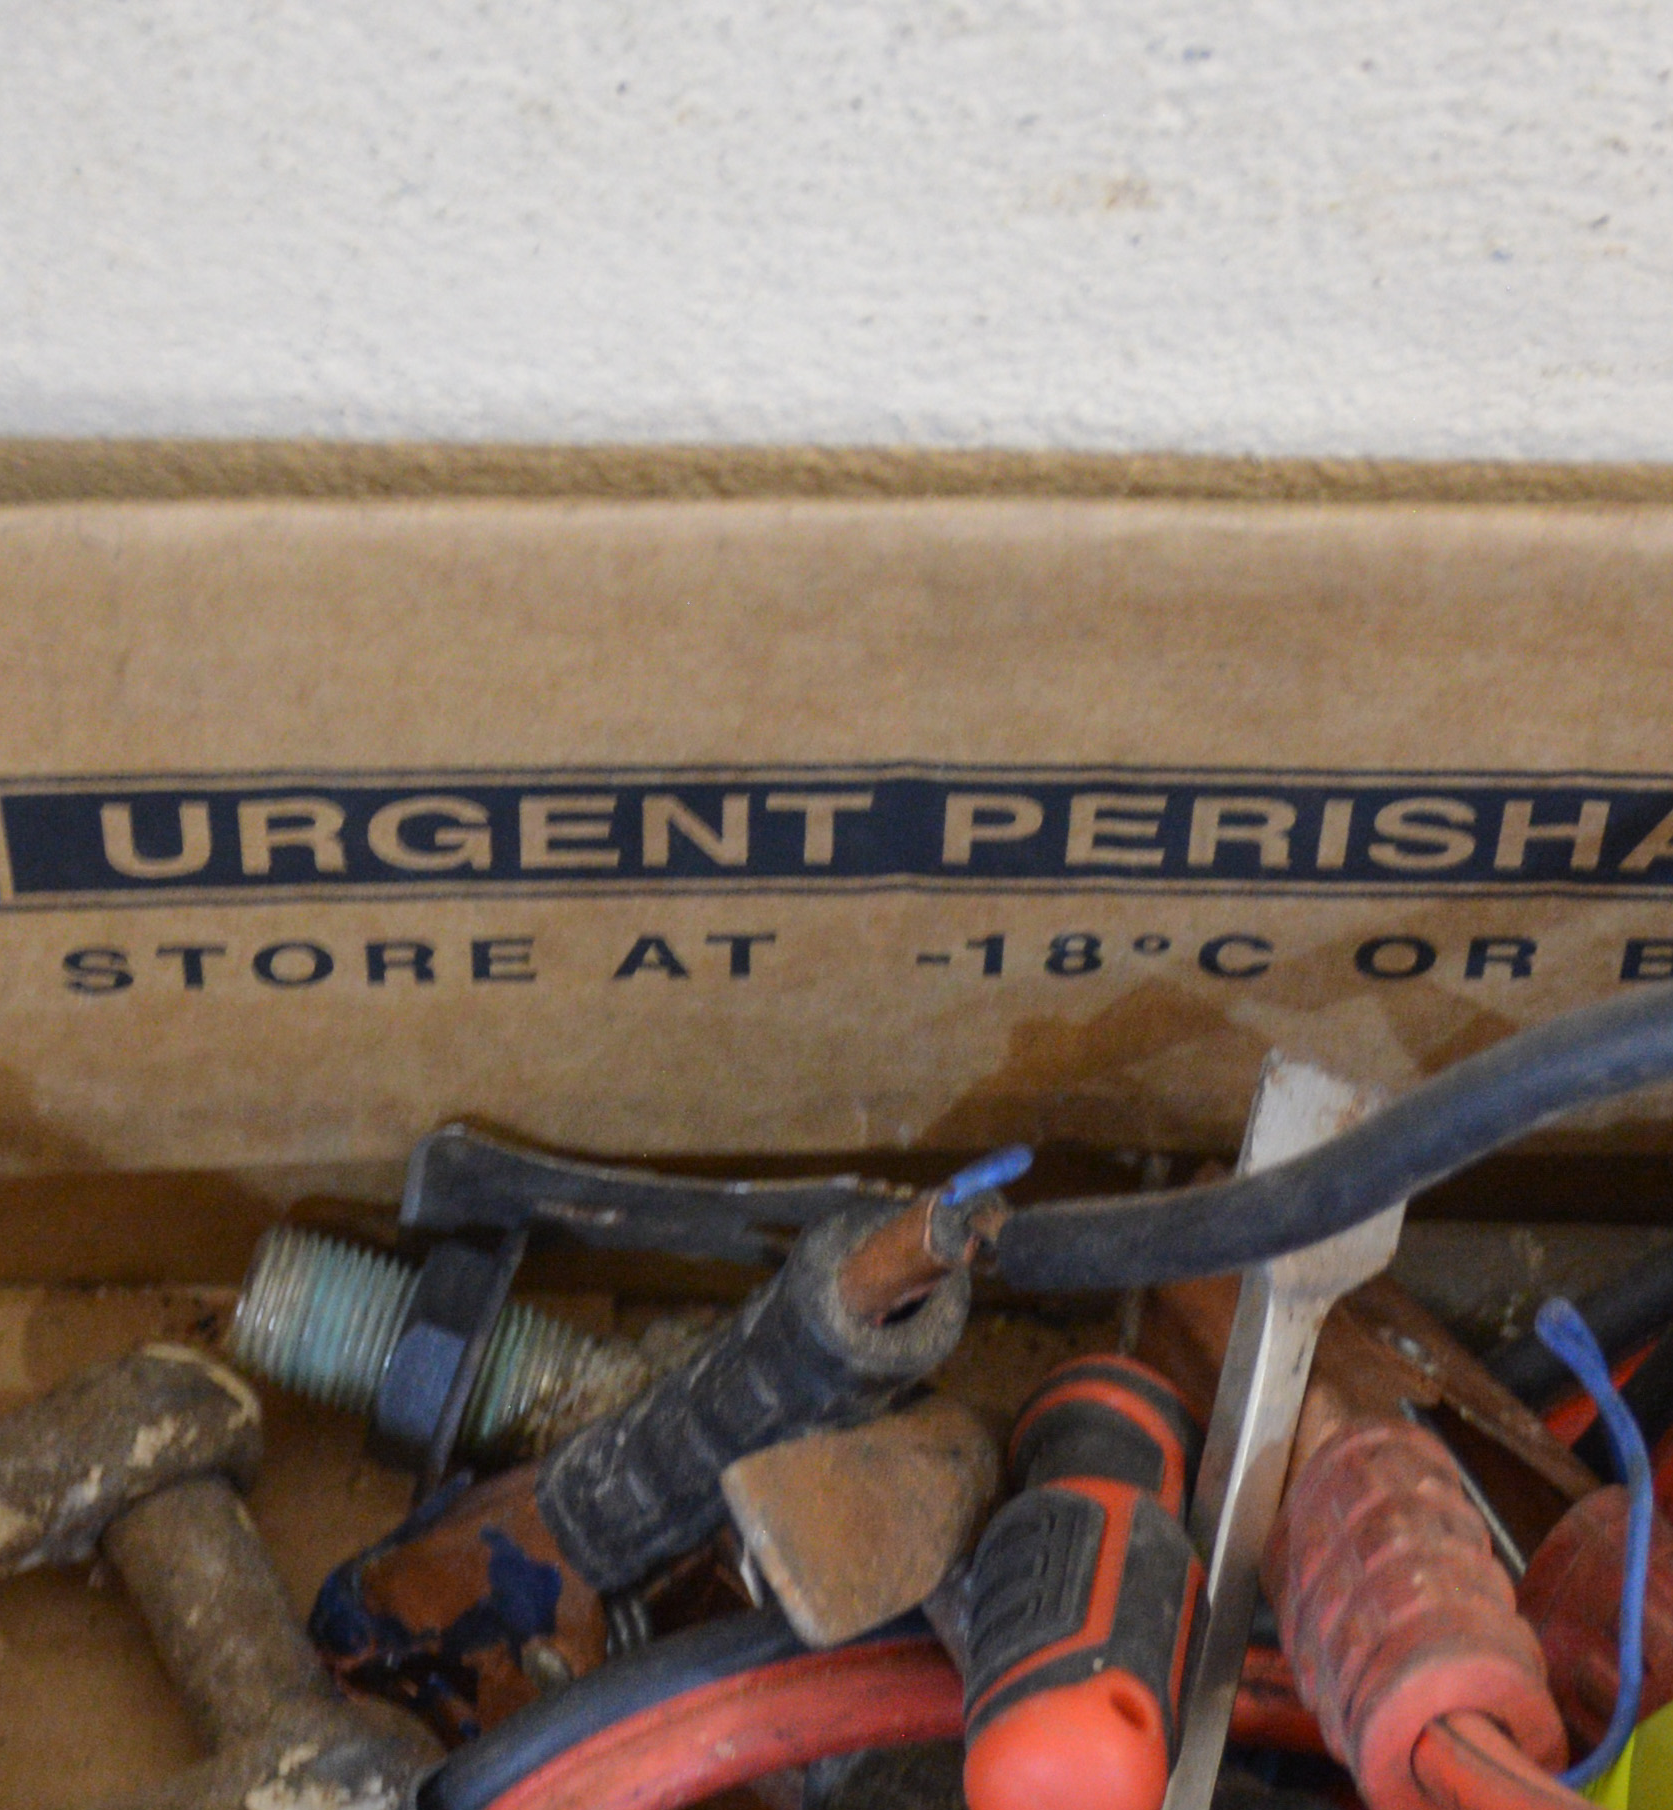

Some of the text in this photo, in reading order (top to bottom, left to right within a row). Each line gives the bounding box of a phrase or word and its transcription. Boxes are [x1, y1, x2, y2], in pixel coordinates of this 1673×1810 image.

[100, 790, 875, 880] URGENT
[62, 934, 538, 996] STORE
[610, 932, 776, 983] AT
[1353, 935, 1539, 980] OR
